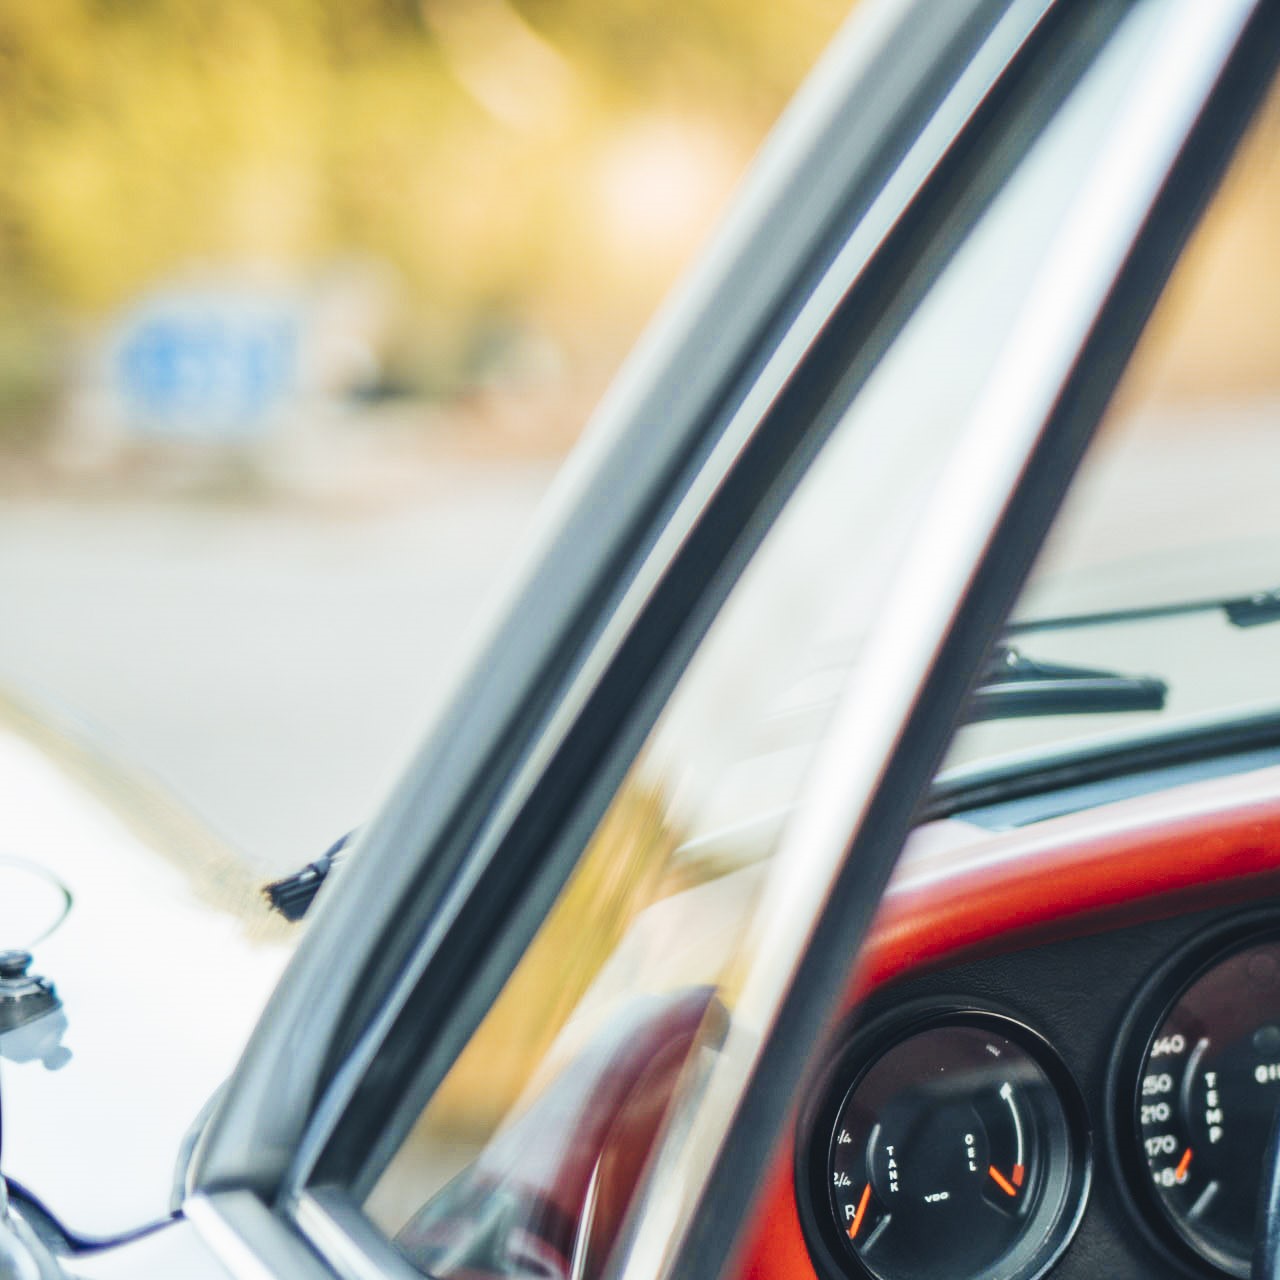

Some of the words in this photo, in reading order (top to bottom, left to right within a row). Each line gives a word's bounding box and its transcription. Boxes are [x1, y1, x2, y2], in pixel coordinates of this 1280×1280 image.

[1205, 1072, 1223, 1143] TEMP
[965, 1134, 977, 1171] OEL
[1145, 1135, 1176, 1156] 170
[886, 1146, 899, 1192] TANK
[845, 1204, 856, 1220] R
[925, 1192, 949, 1203] VDO
